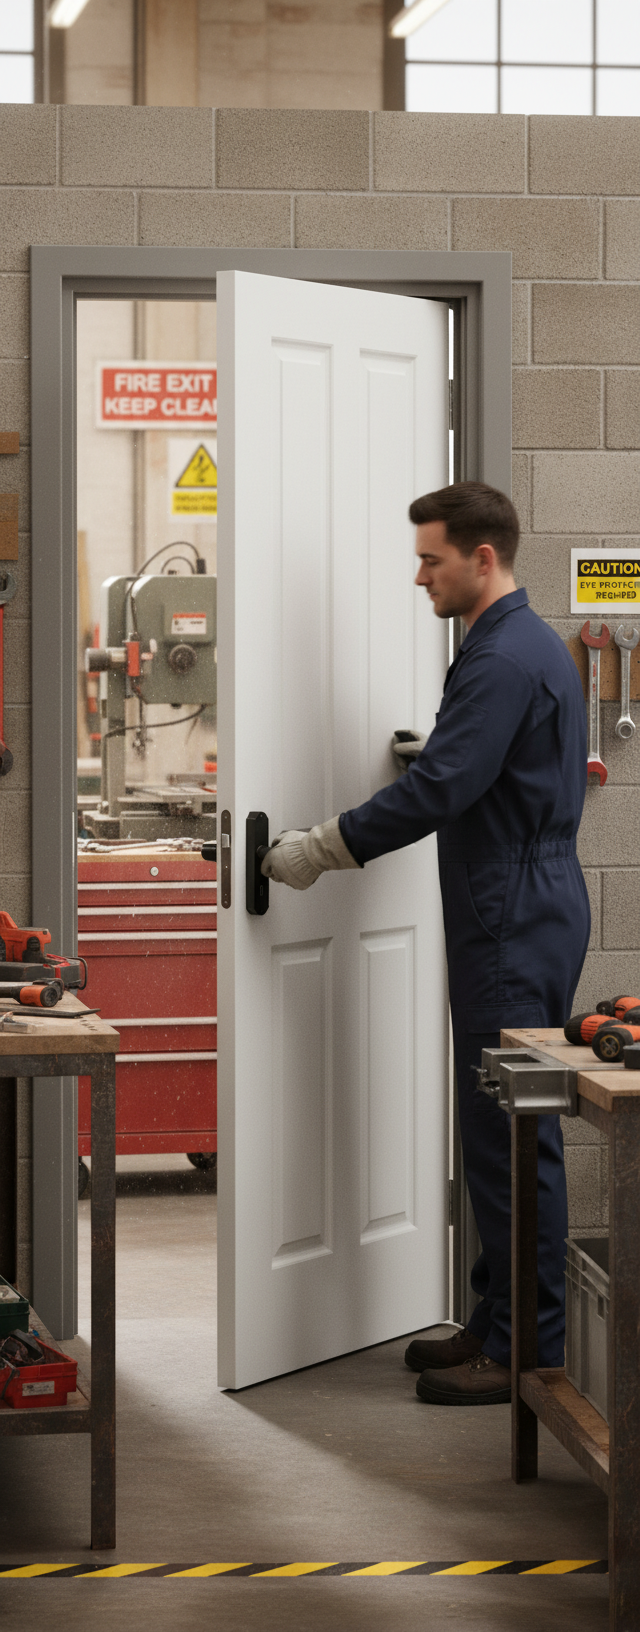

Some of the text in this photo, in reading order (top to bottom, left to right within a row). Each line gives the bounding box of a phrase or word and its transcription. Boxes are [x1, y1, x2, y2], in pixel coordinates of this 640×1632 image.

[114, 373, 213, 393] FIRE EXIT
[105, 397, 157, 415] KEEP
[580, 562, 640, 575] CAUTION
[580, 581, 597, 589] EYE
